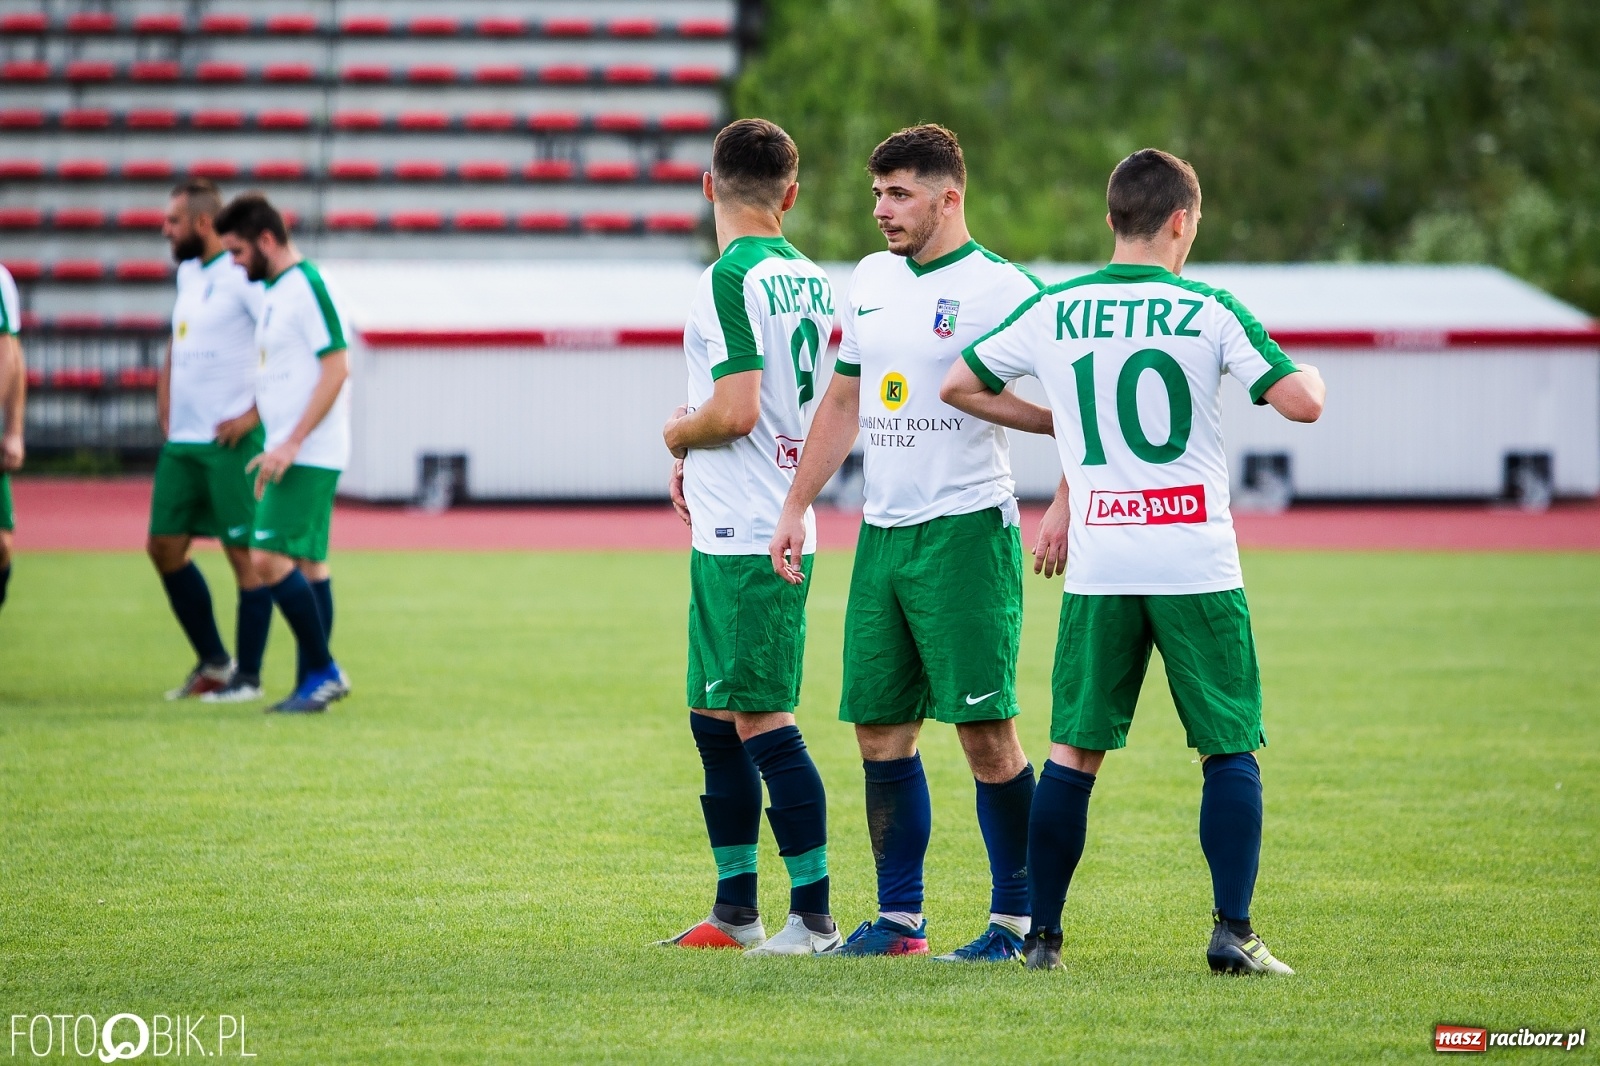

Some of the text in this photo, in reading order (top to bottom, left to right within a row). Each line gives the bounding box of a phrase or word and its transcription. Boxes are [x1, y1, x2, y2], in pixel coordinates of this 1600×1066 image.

[759, 274, 834, 316] KIETRZ
[1055, 298, 1204, 341] KIETRZ
[790, 317, 820, 410] 9
[859, 415, 965, 431] OMBINAT ROLNY
[1071, 348, 1193, 466] 10
[870, 432, 916, 448] KIETRZ
[1096, 494, 1199, 519] DAR-BUD
